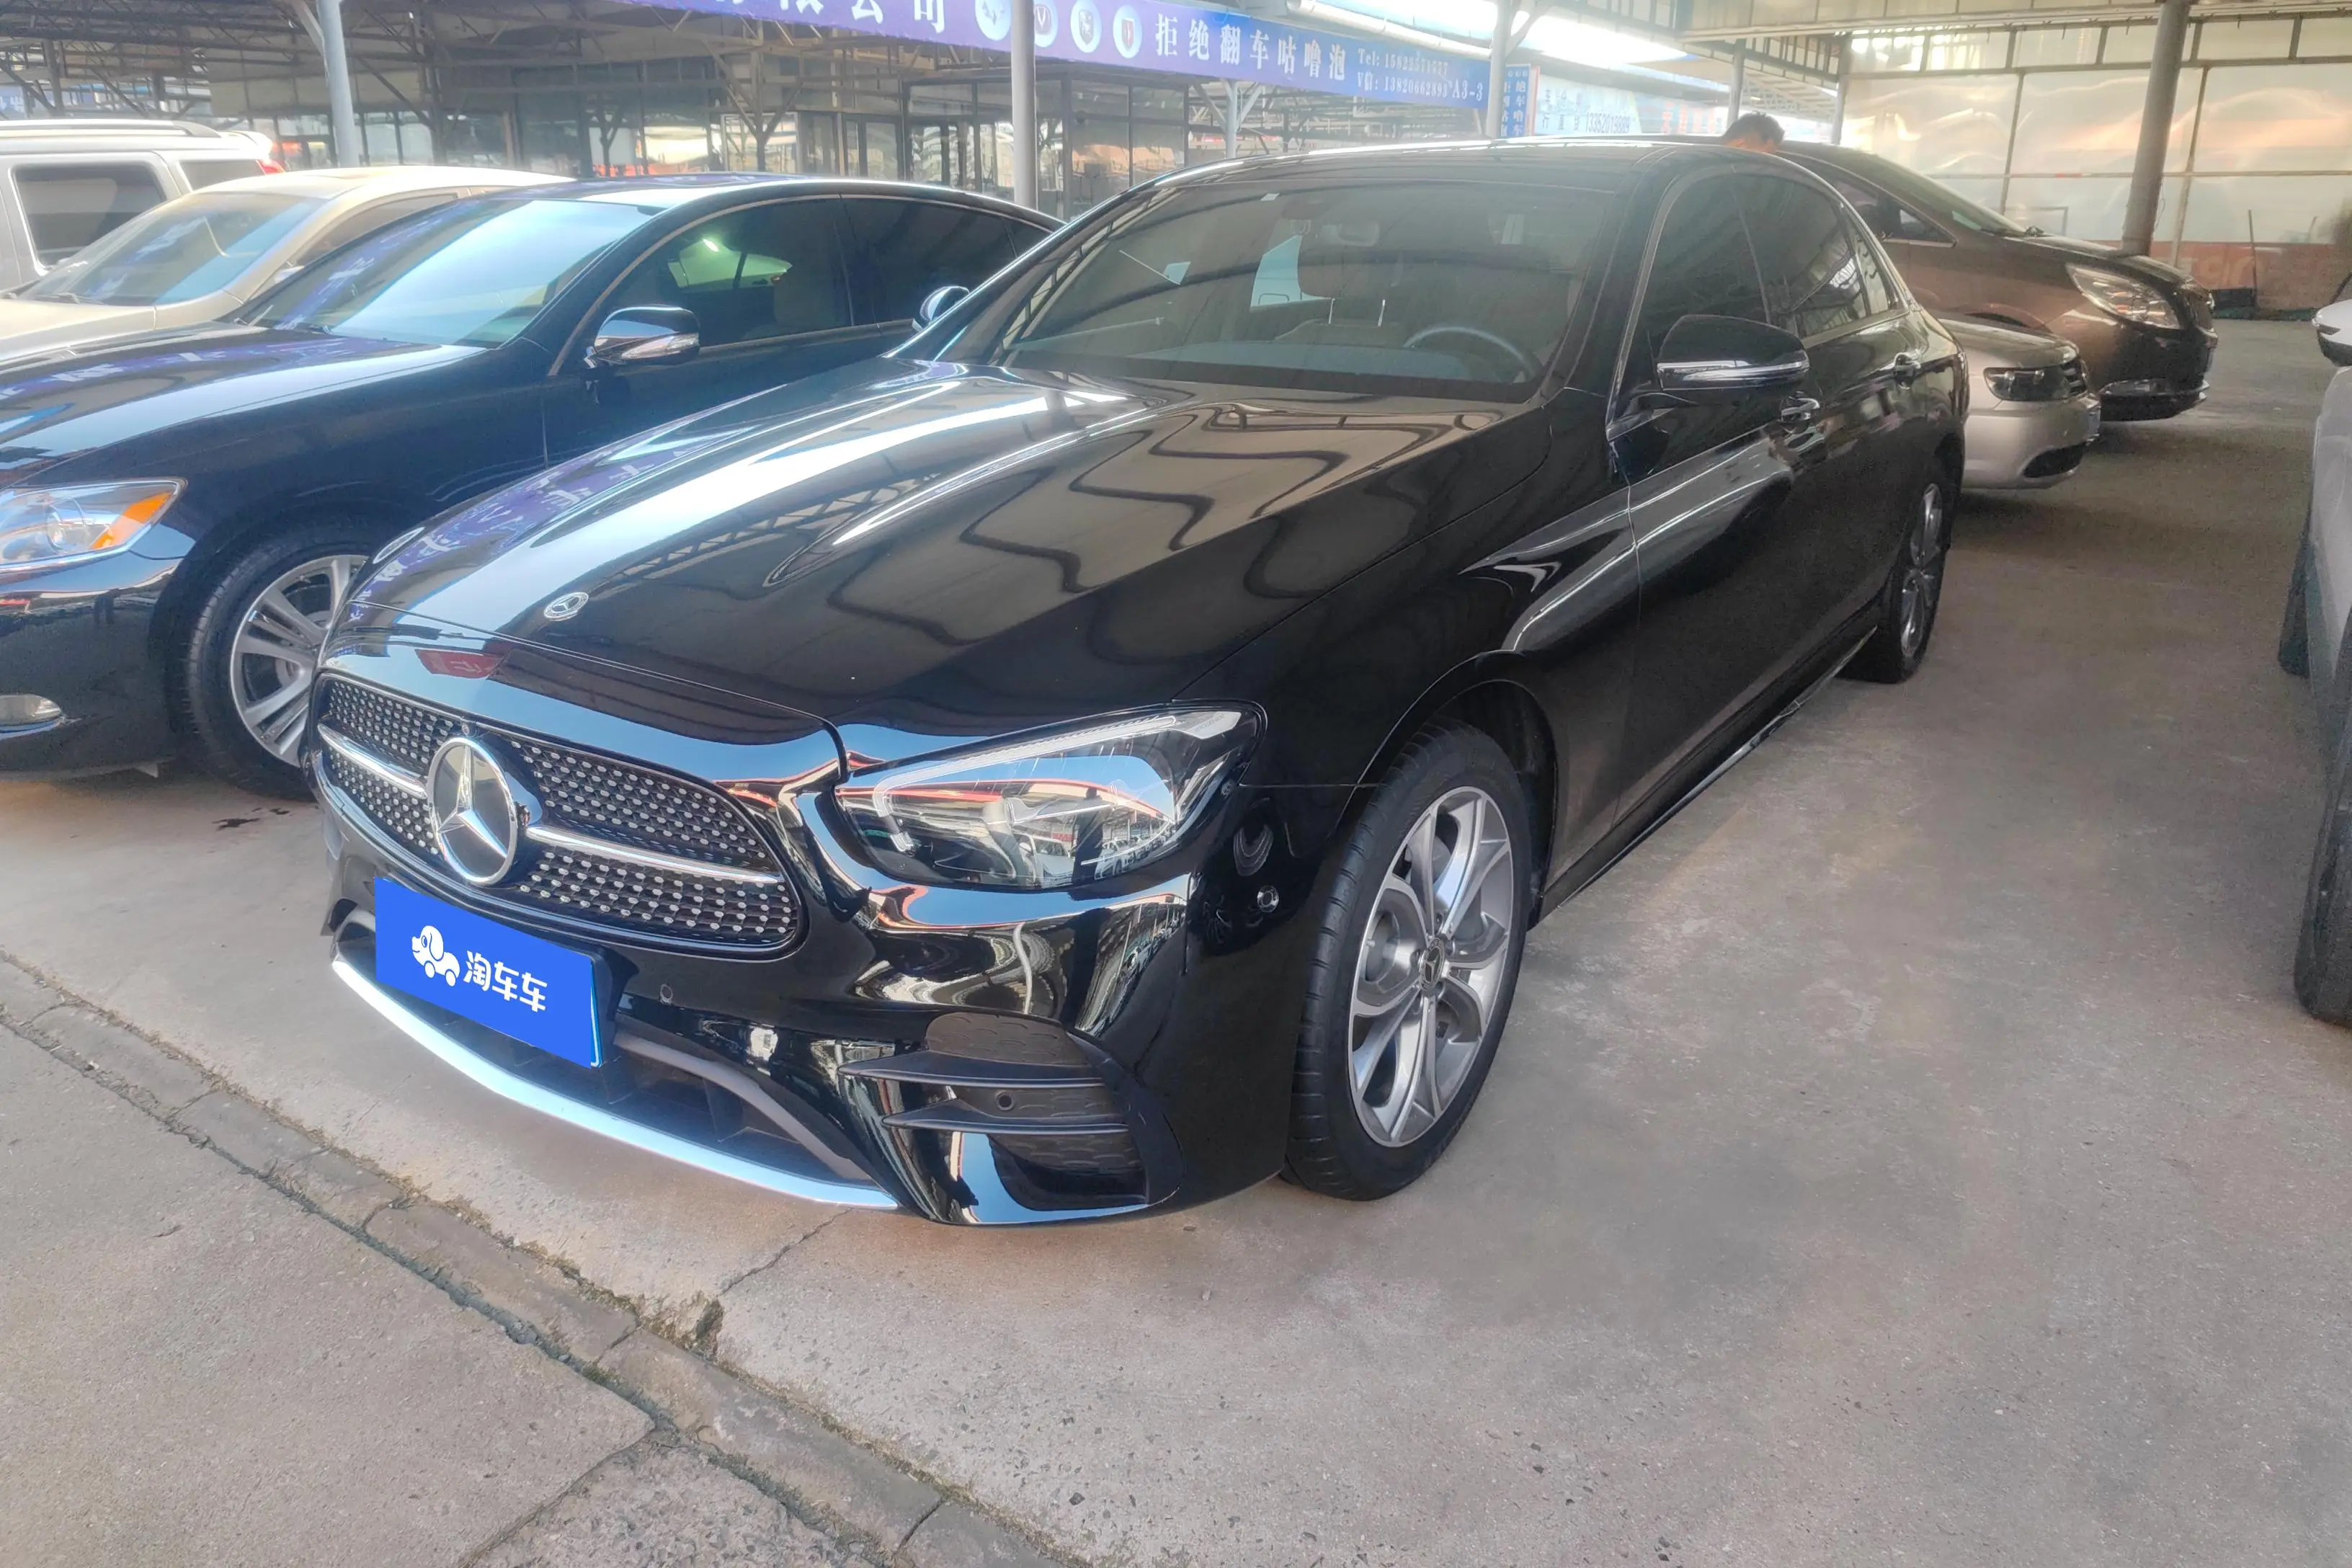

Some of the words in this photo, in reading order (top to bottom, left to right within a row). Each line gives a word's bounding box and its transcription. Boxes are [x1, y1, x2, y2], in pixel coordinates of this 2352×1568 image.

[1155, 13, 1346, 81] 拒绝翻车咕噜泡
[1358, 48, 1379, 66] Tel:
[1452, 78, 1483, 102] A3-3
